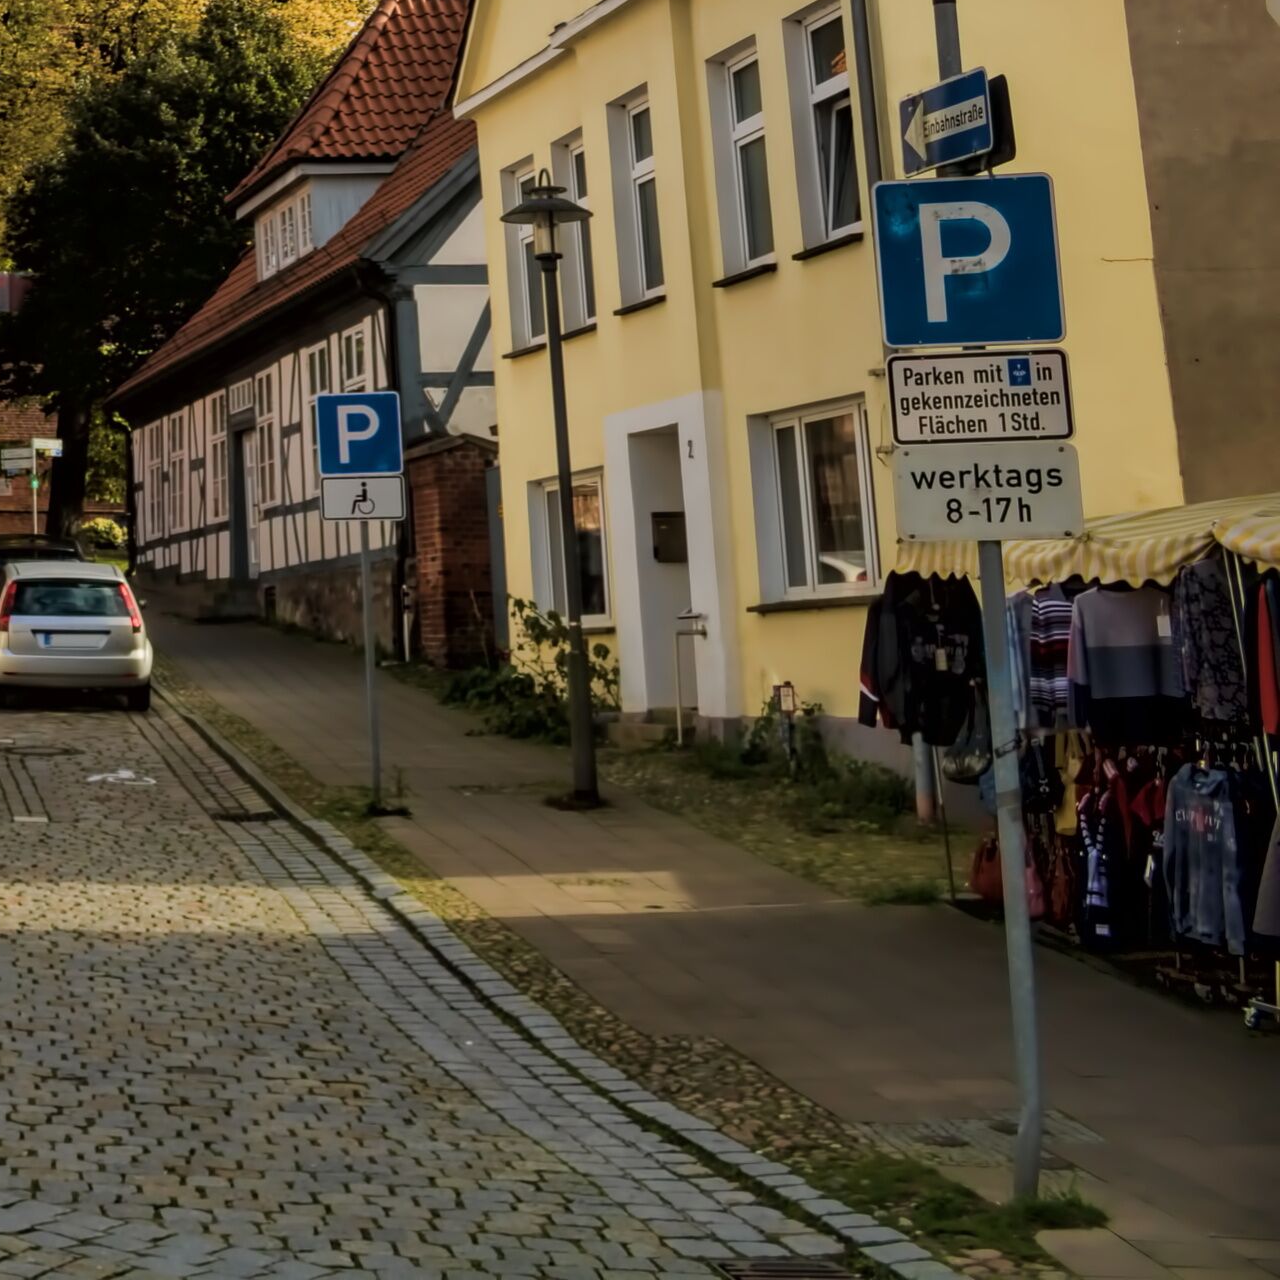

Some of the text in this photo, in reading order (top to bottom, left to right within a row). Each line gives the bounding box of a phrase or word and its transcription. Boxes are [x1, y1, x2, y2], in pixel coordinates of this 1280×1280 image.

[922, 103, 984, 138] Einbahnstraße
[918, 201, 1012, 323] P
[902, 361, 1053, 387] Parken mit in
[899, 388, 1061, 416] gekennzeichneten
[336, 404, 380, 464] P
[918, 415, 988, 435] Flächen
[910, 462, 1064, 494] werktags
